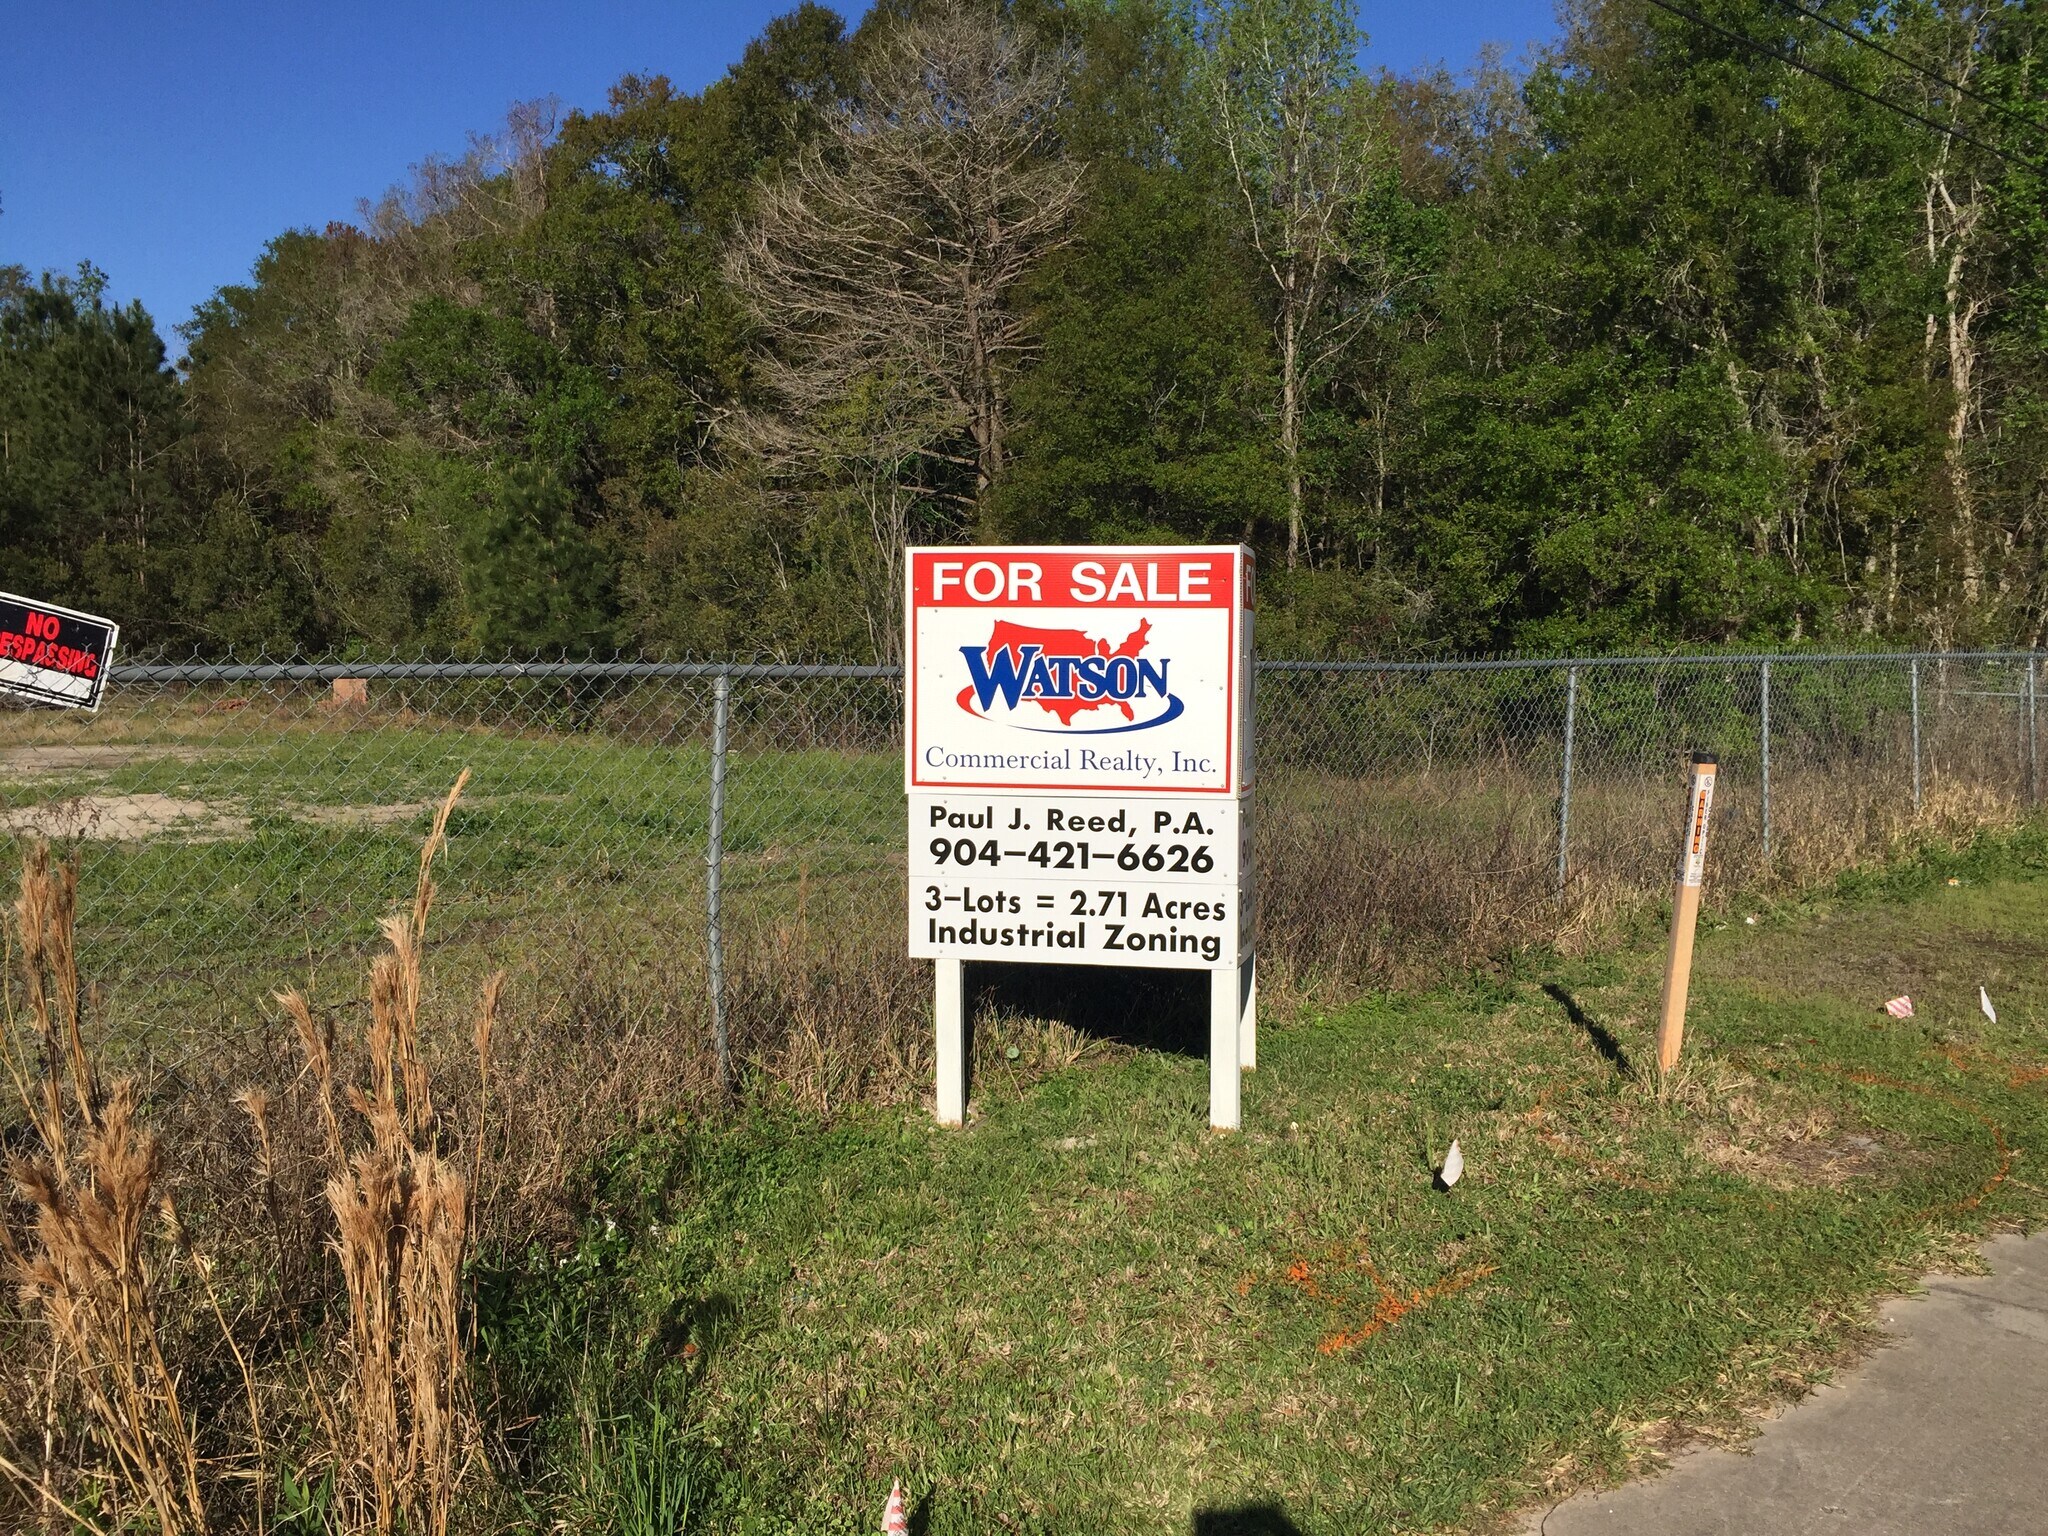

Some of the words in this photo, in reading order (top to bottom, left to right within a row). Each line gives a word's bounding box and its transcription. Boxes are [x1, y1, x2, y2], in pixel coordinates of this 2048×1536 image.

[934, 561, 1043, 602] FOR
[1070, 561, 1212, 603] SALE
[26, 611, 60, 641] NO
[0, 631, 97, 678] ESPASSING
[959, 644, 1171, 713] WATSON
[925, 746, 1071, 772] Commercial
[1079, 749, 1163, 779] Realty,
[1171, 750, 1217, 773] Inc.
[930, 805, 993, 829] Paul
[1007, 807, 1031, 831] J.
[1047, 808, 1137, 838] Reed,
[1154, 810, 1214, 835] P.A.
[929, 837, 1214, 874] 904-421-6626
[925, 885, 1021, 915] 3-Lots
[1036, 895, 1055, 909] =
[1070, 890, 1128, 917] 2.71
[1142, 892, 1226, 921] Acres
[929, 918, 1086, 949] Industrial
[1103, 923, 1222, 962] Zoning
